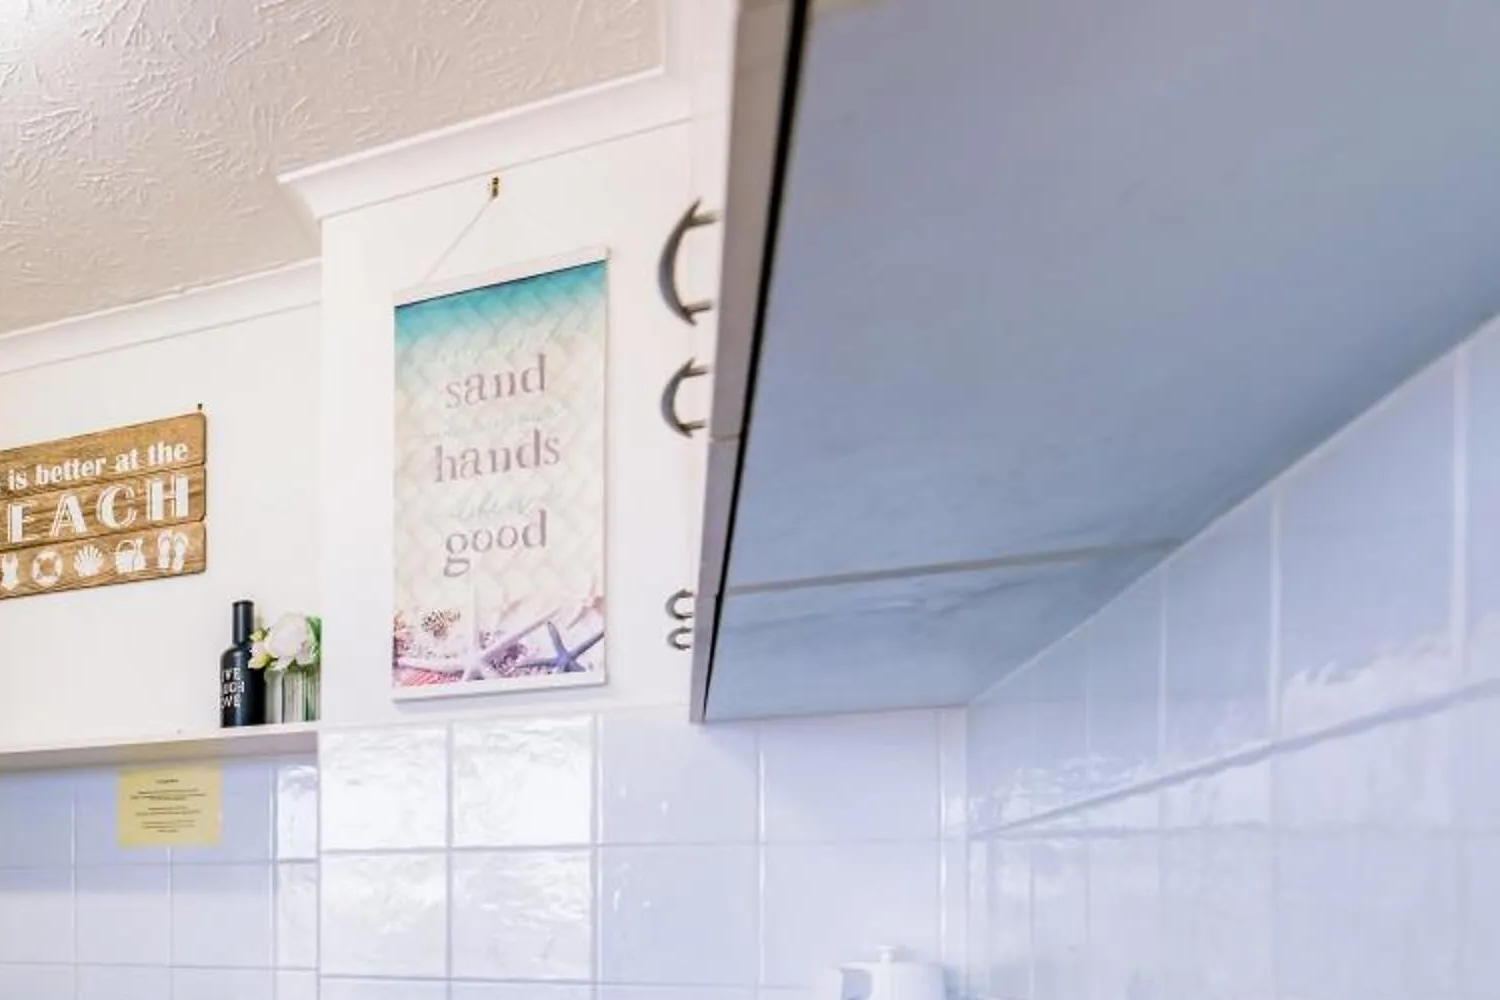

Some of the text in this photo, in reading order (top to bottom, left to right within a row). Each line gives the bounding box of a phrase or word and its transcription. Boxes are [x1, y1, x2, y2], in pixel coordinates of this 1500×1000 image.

[445, 353, 547, 409] sand
[8, 468, 27, 491] is
[35, 455, 107, 486] better
[115, 448, 139, 471] at
[148, 440, 189, 467] the
[434, 429, 561, 484] hands
[442, 510, 548, 577] good
